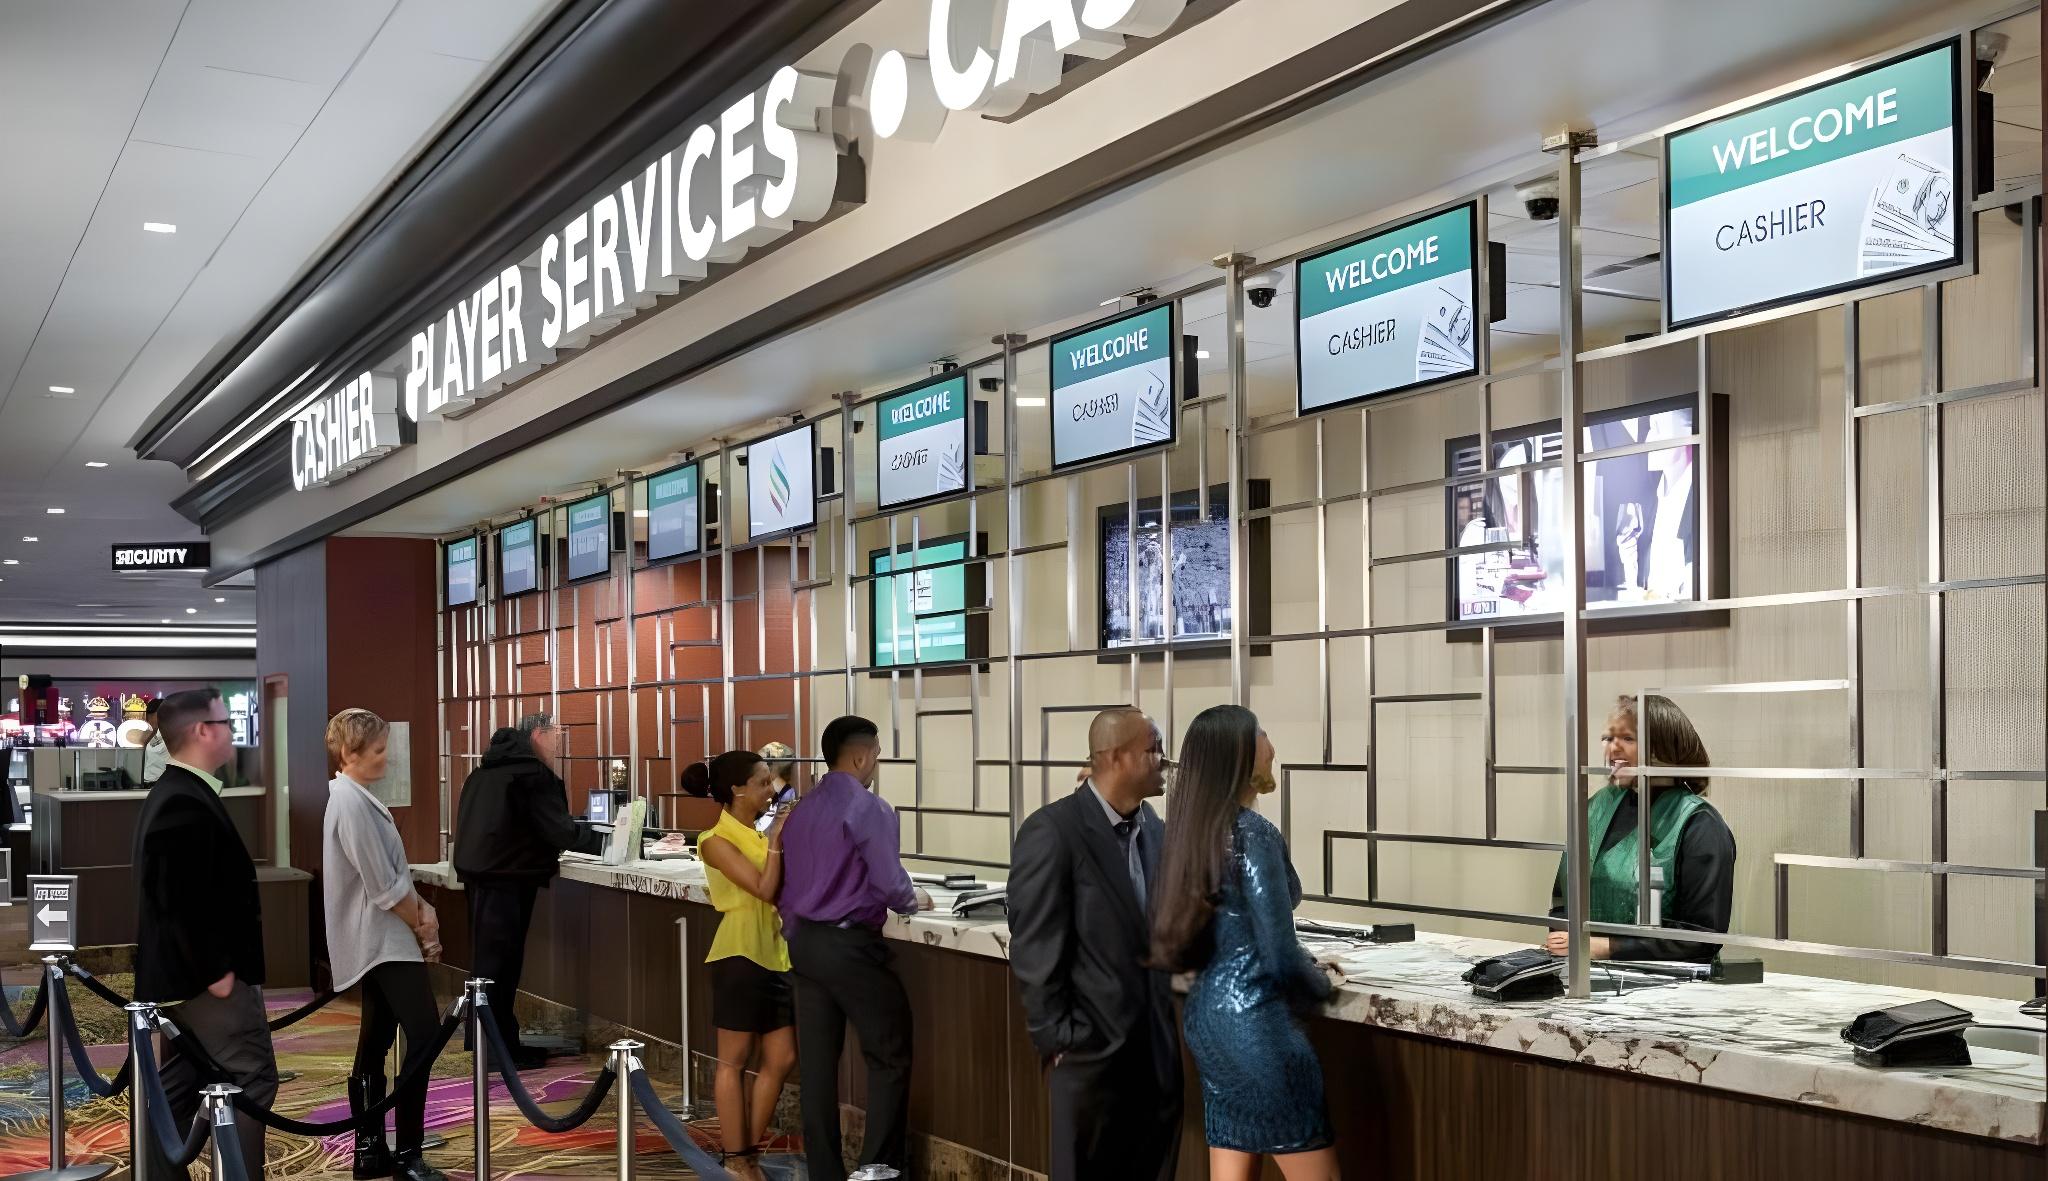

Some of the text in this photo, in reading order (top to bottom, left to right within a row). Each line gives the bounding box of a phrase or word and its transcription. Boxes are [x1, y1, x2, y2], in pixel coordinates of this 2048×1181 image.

[1712, 87, 1898, 175] WELCOME
[1715, 199, 1826, 251] CASHIER
[291, 370, 377, 492] CASHIER
[411, 264, 528, 414] PLAYER
[540, 65, 799, 349] SERVICES
[1325, 235, 1439, 293] WELCOME
[1070, 327, 1148, 371] WELCOME
[1328, 318, 1396, 356] CASHIER
